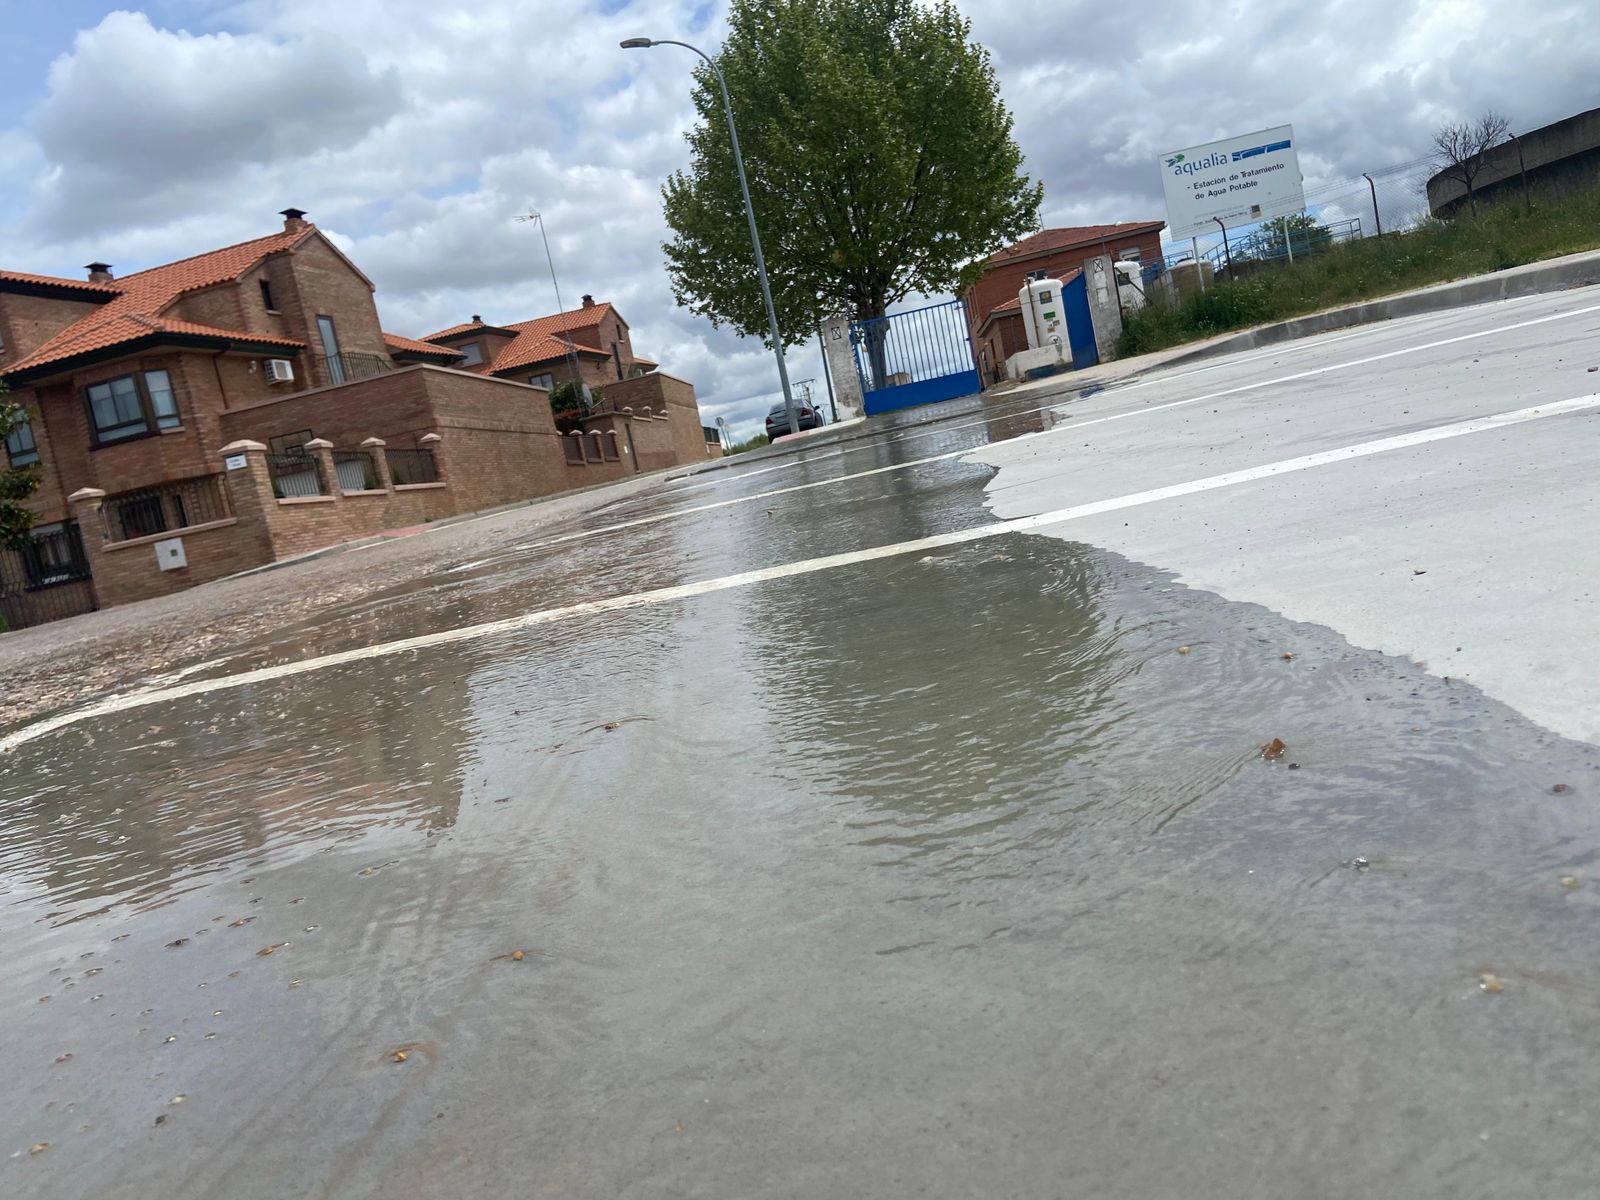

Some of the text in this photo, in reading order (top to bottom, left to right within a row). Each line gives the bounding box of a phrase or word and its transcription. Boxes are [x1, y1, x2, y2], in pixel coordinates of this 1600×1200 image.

[1174, 152, 1228, 176] aqualia
[1193, 177, 1226, 190] Estación
[1229, 174, 1239, 182] de
[1240, 163, 1285, 178] Tratamiento
[1208, 188, 1227, 198] Agua
[1229, 180, 1258, 192] Potable
